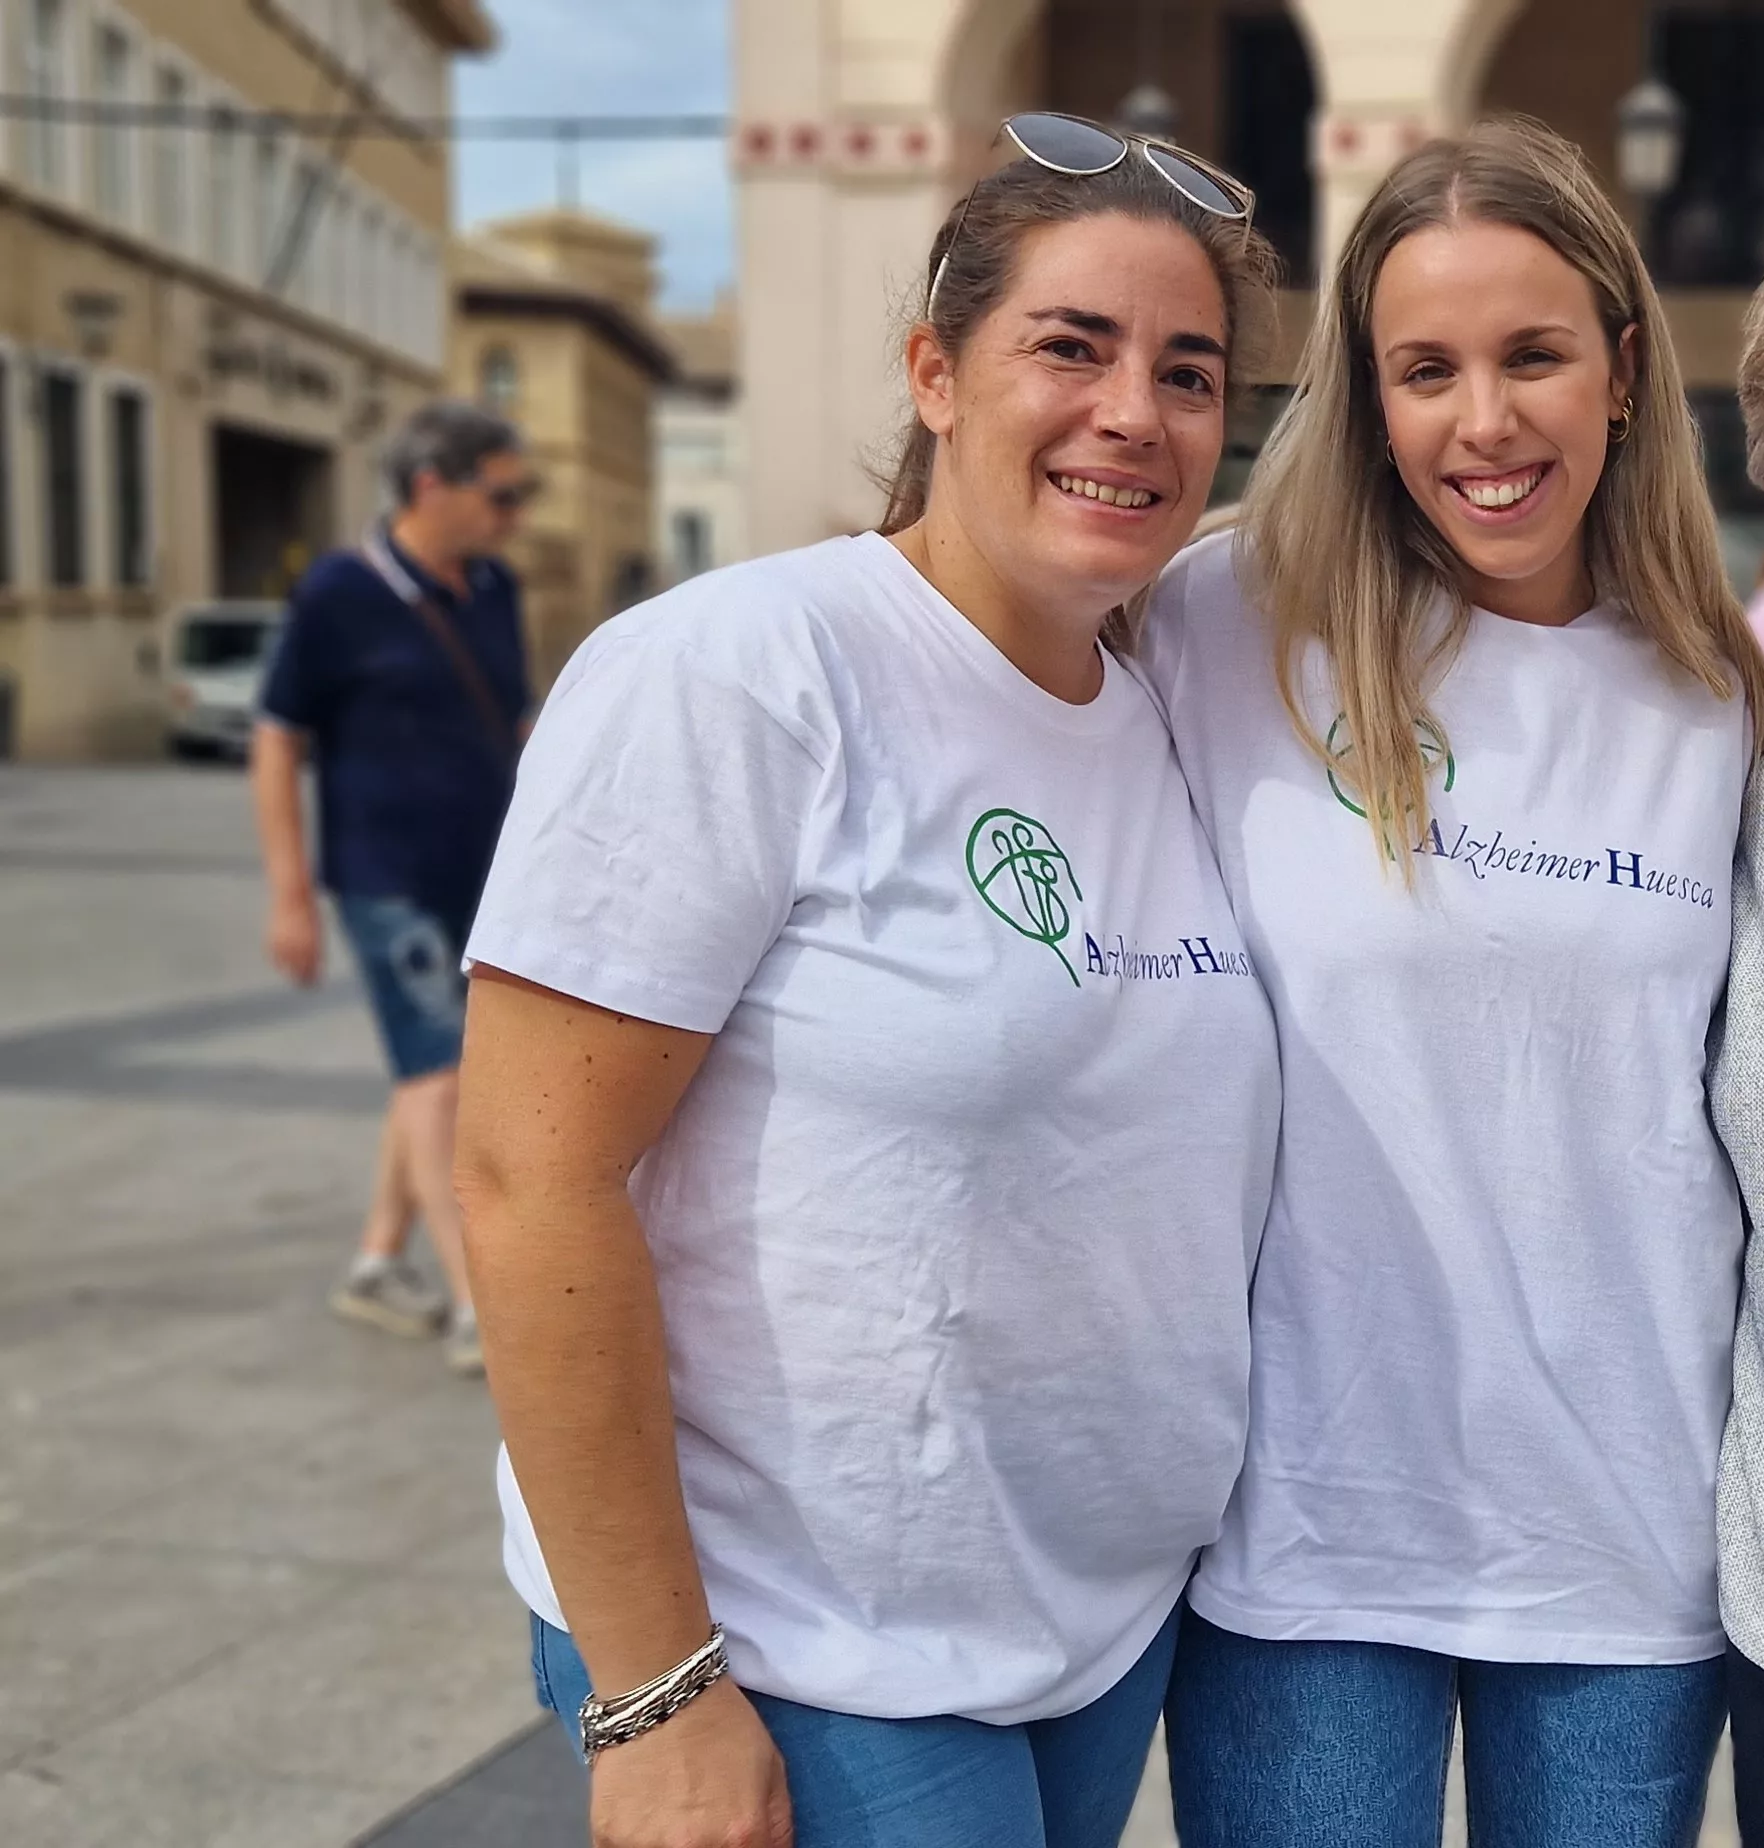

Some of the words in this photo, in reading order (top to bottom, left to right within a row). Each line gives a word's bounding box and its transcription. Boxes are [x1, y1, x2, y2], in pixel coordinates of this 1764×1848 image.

[1412, 817, 1601, 880] Alzheimer
[1604, 847, 1715, 910] Huesca
[1177, 936, 1256, 978] Hues
